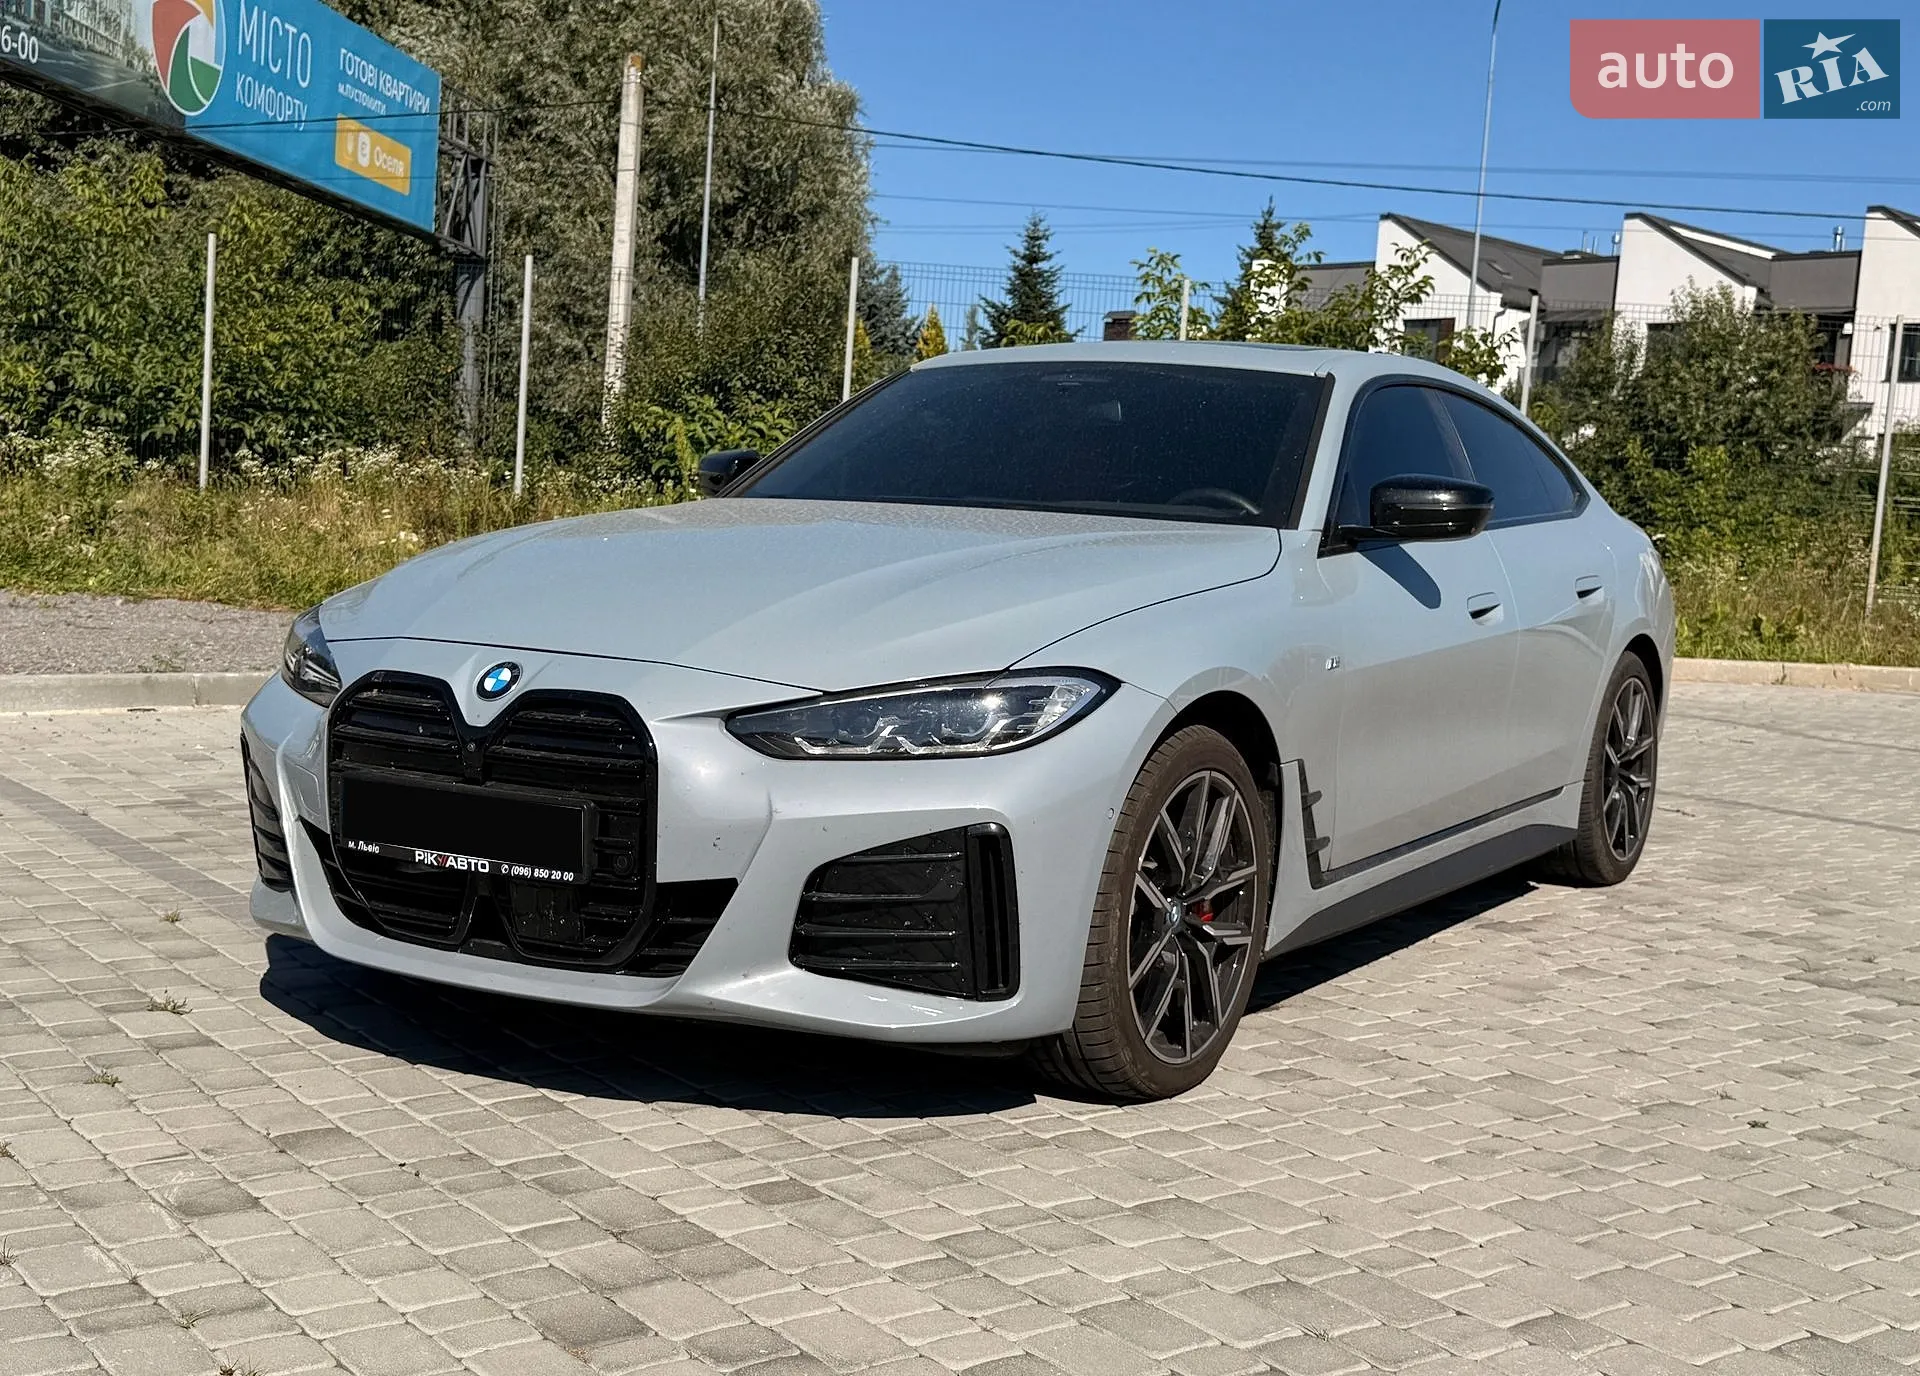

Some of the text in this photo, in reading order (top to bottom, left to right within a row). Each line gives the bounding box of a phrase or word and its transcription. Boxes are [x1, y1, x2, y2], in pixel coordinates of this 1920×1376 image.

[238, 0, 312, 89] МІСТО
[235, 72, 308, 131] КОМФОРТУ
[339, 47, 431, 116] ГОТОВІ КВАРТИРИ
[510, 865, 532, 878] (096)
[533, 868, 549, 879] 850
[551, 870, 562, 880] 20
[563, 871, 574, 882] 00
